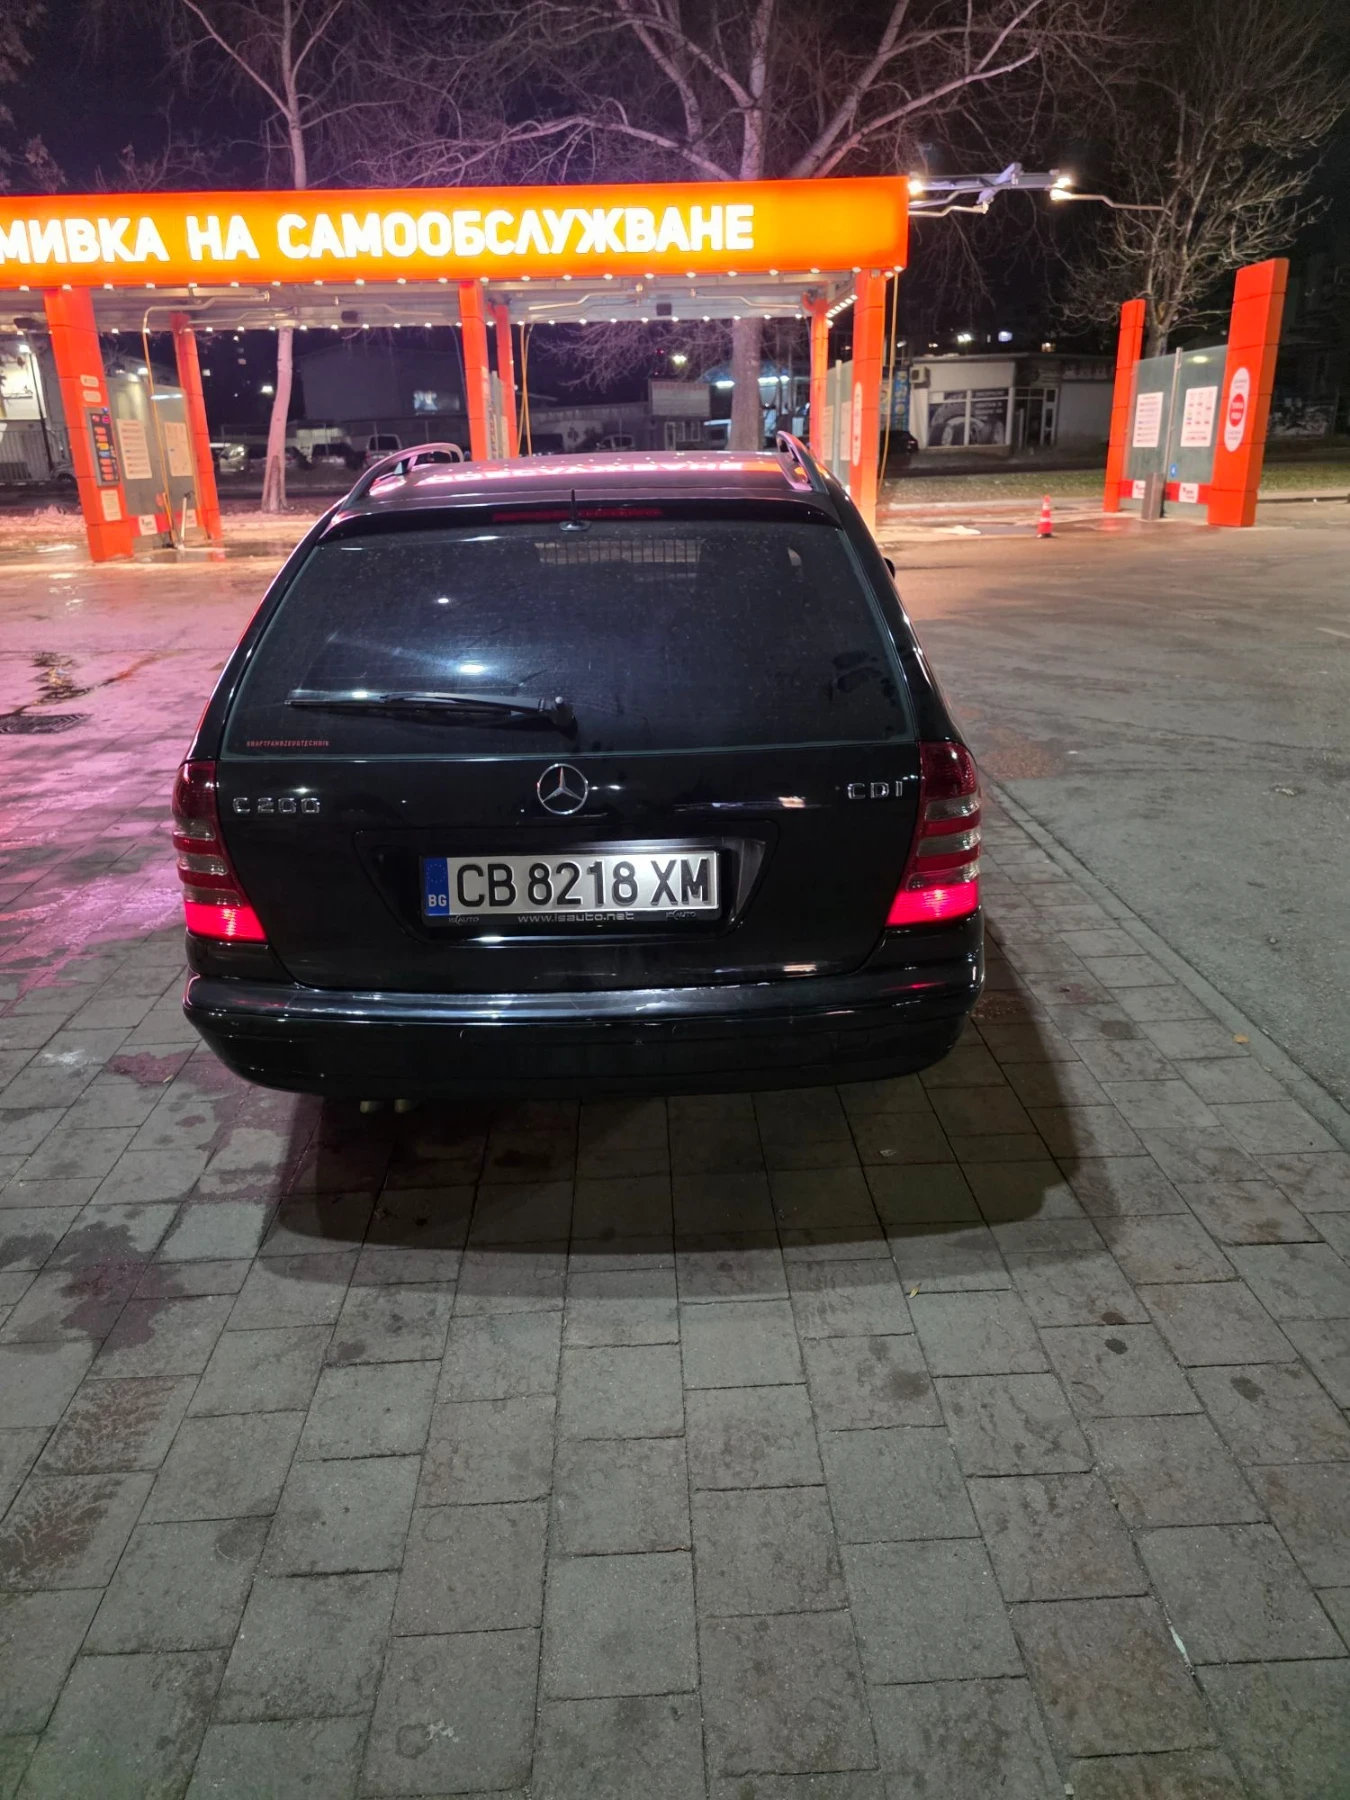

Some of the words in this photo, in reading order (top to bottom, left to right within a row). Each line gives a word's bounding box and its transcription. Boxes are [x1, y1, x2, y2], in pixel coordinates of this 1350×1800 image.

[0, 217, 170, 264] МИВКА
[186, 215, 260, 260] НА
[277, 205, 753, 258] САМООБСЛУЖВАНЕ
[847, 781, 903, 799] CDI
[233, 797, 250, 813] C
[258, 797, 320, 813] 200
[457, 863, 517, 907] CB
[528, 861, 638, 907] 8218
[649, 858, 711, 906] XM
[428, 894, 447, 907] BG
[517, 911, 635, 923] www.isauto.net
